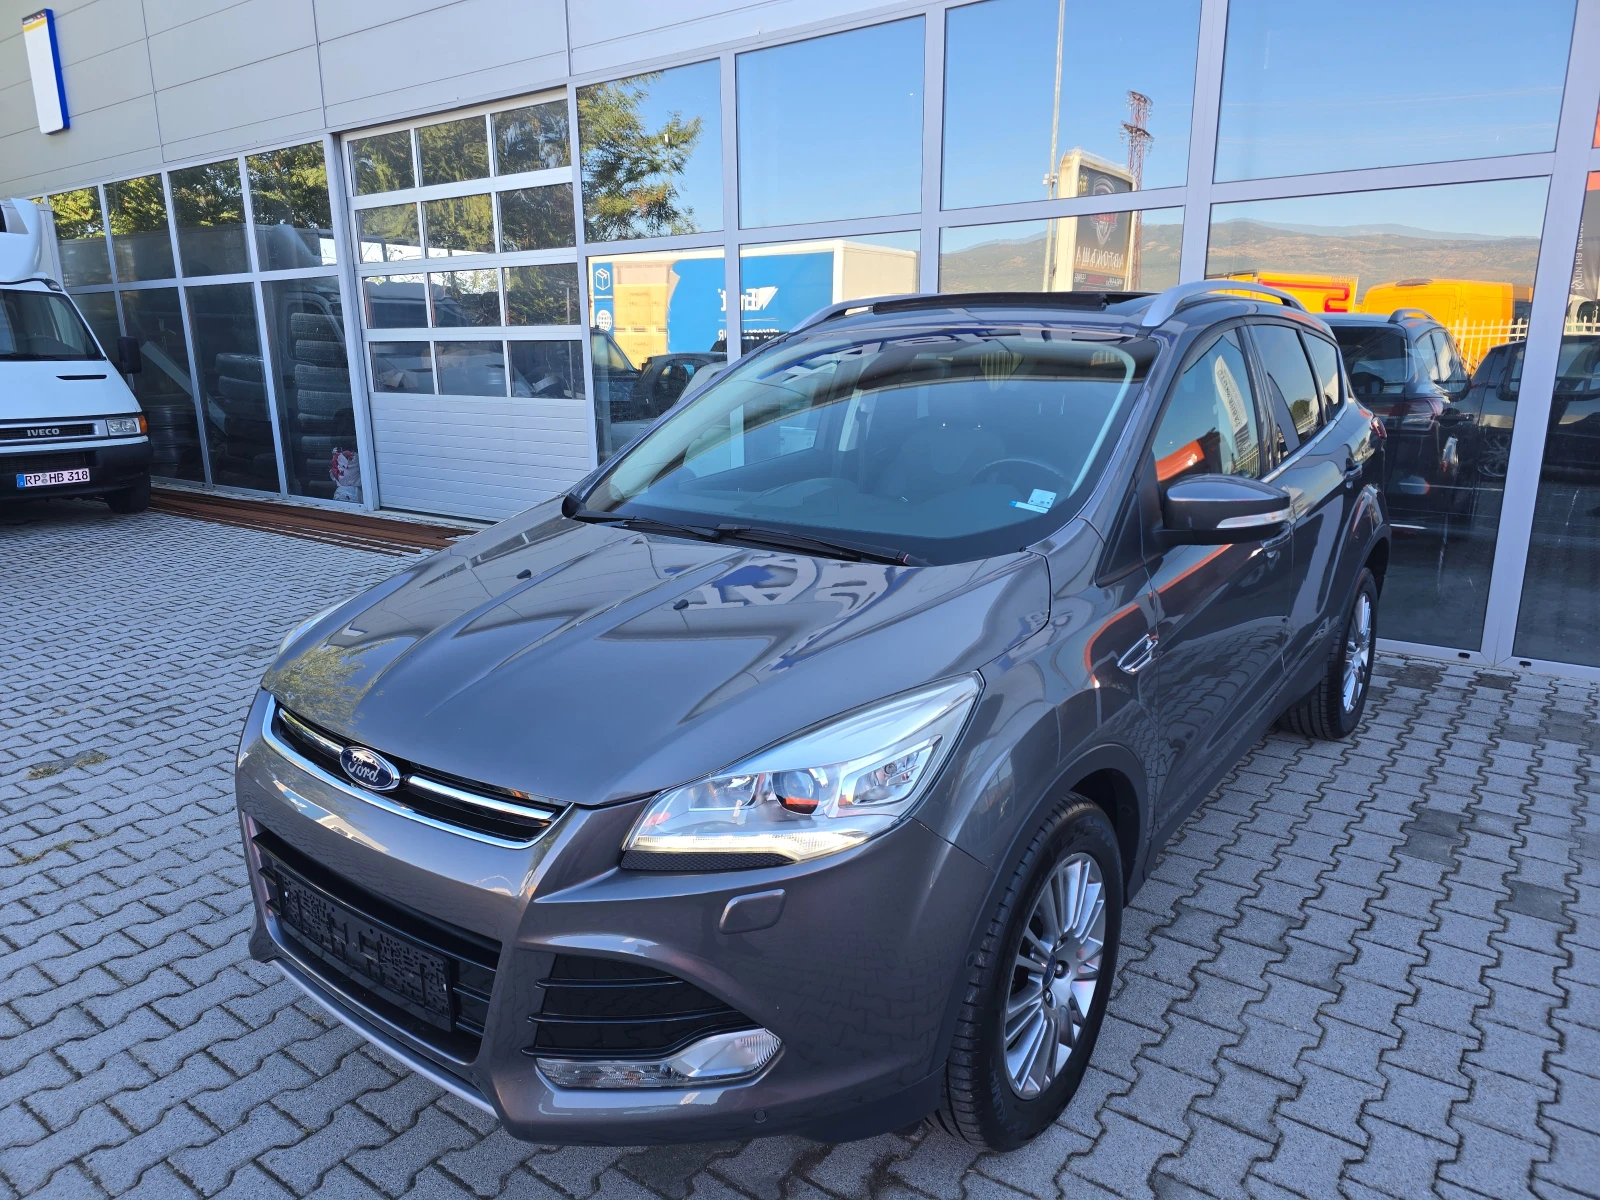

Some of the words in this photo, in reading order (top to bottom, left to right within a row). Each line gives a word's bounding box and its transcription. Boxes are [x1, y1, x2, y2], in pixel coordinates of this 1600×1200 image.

[26, 428, 60, 437] IVECO
[25, 474, 41, 486] RP
[49, 472, 65, 484] HB
[67, 470, 89, 482] 318
[347, 757, 379, 783] Ford
